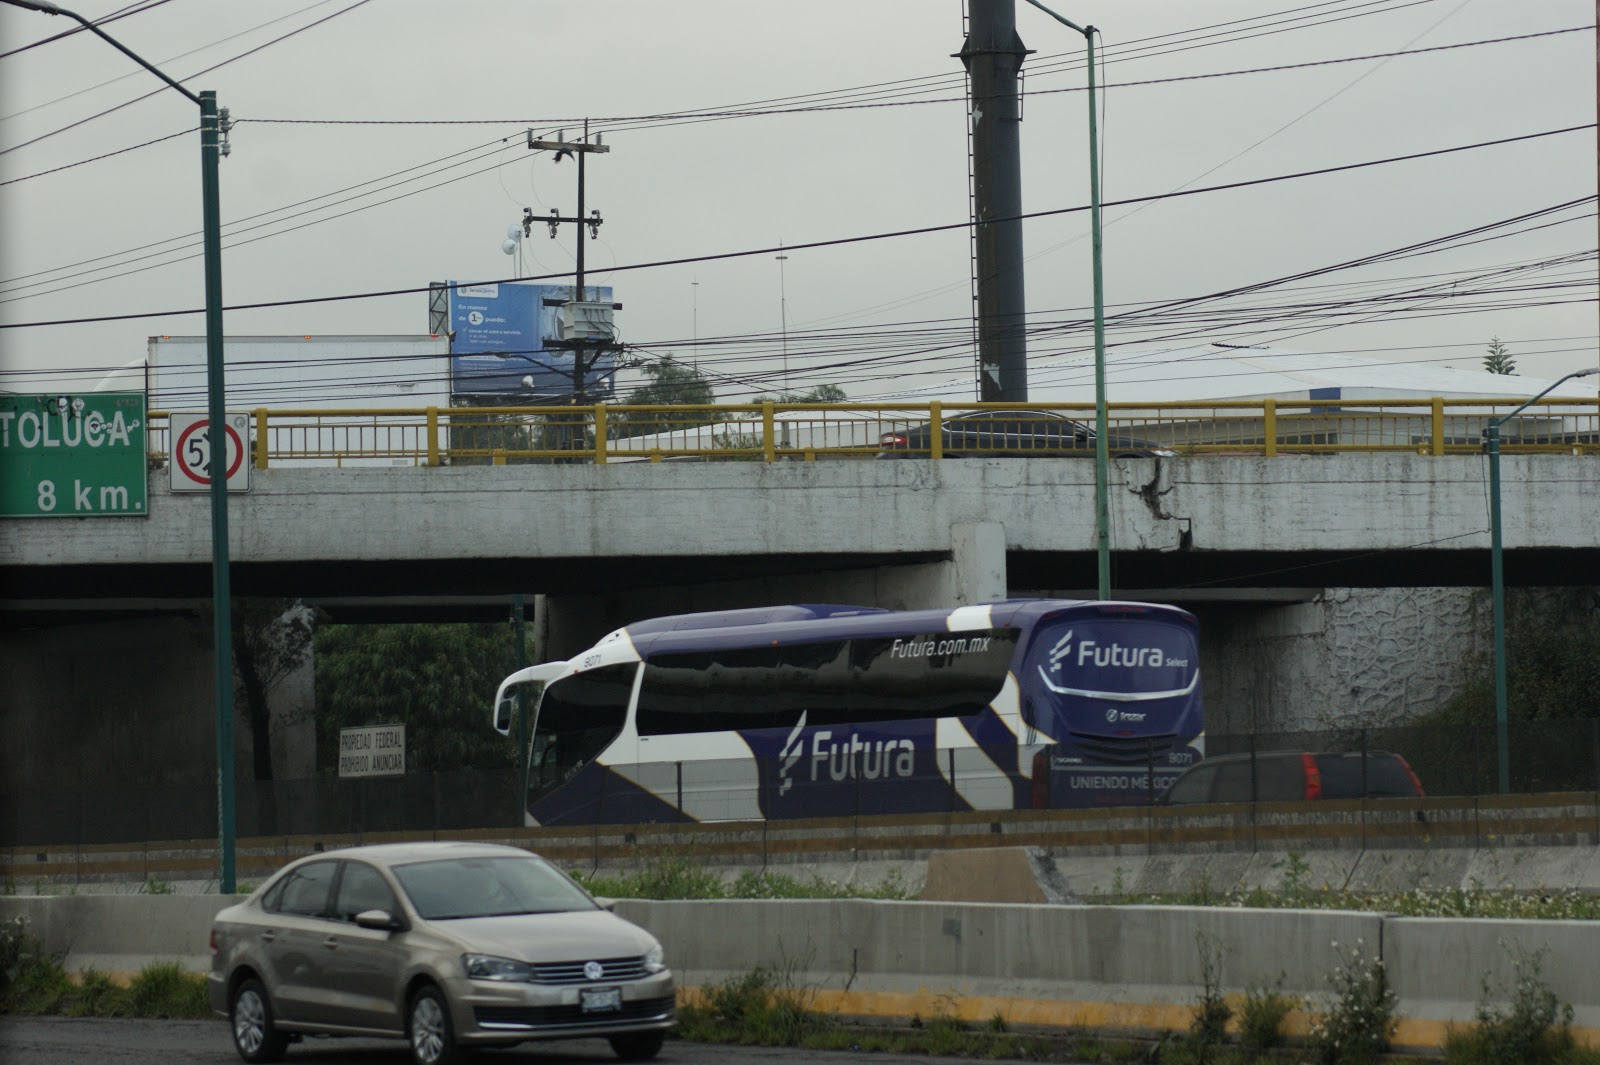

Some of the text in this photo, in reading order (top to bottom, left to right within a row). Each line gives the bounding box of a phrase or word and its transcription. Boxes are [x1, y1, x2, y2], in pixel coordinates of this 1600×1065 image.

[0, 411, 130, 449] TOLUCA
[37, 479, 57, 511] 8
[890, 637, 991, 658] Futura.com.mx
[1077, 640, 1189, 667] Futura Select
[341, 731, 402, 752] PROPIEDAD FEDERAL
[340, 752, 403, 774] PROHIBIDO ANUNCIAR
[810, 730, 916, 782] Futura
[1070, 775, 1129, 789] UNIENDO
